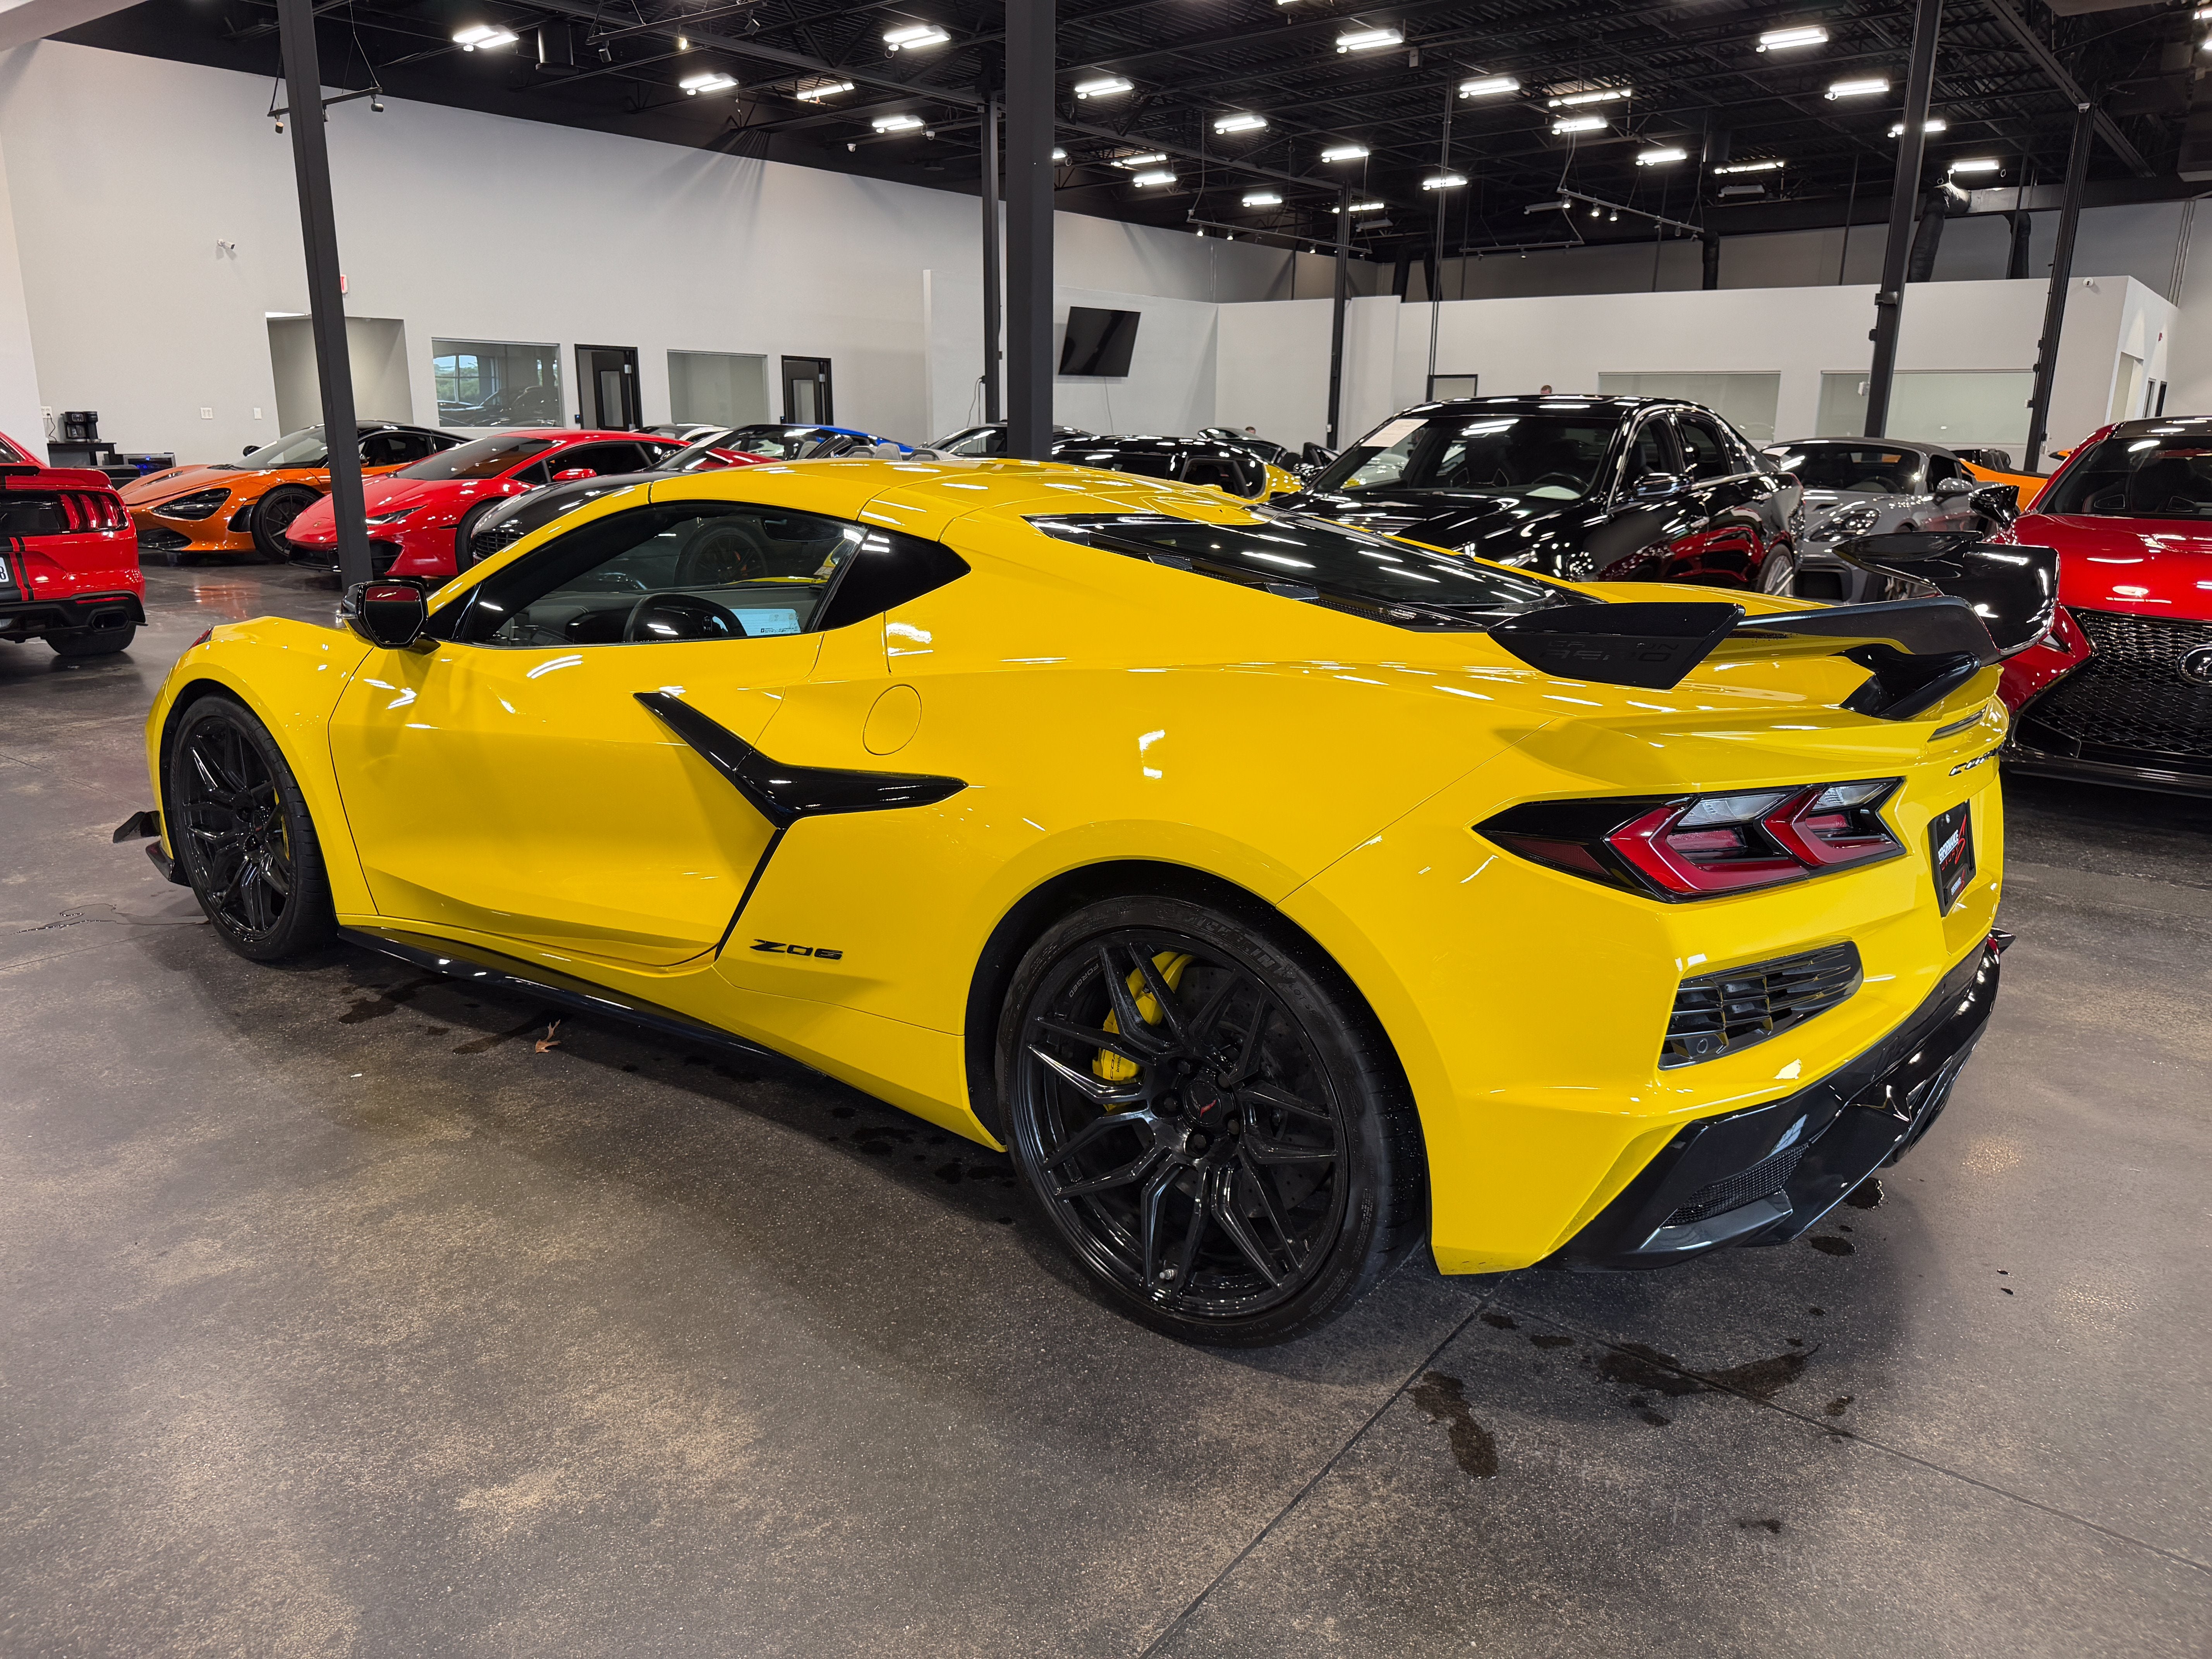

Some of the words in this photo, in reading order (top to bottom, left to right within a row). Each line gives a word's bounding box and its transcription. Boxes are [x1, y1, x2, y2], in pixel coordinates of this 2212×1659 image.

[1547, 640, 1680, 651] CAON
[1938, 829, 1958, 861] ERFORMANCE
[749, 939, 843, 960] Z06
[1069, 963, 1099, 998] FORGED
